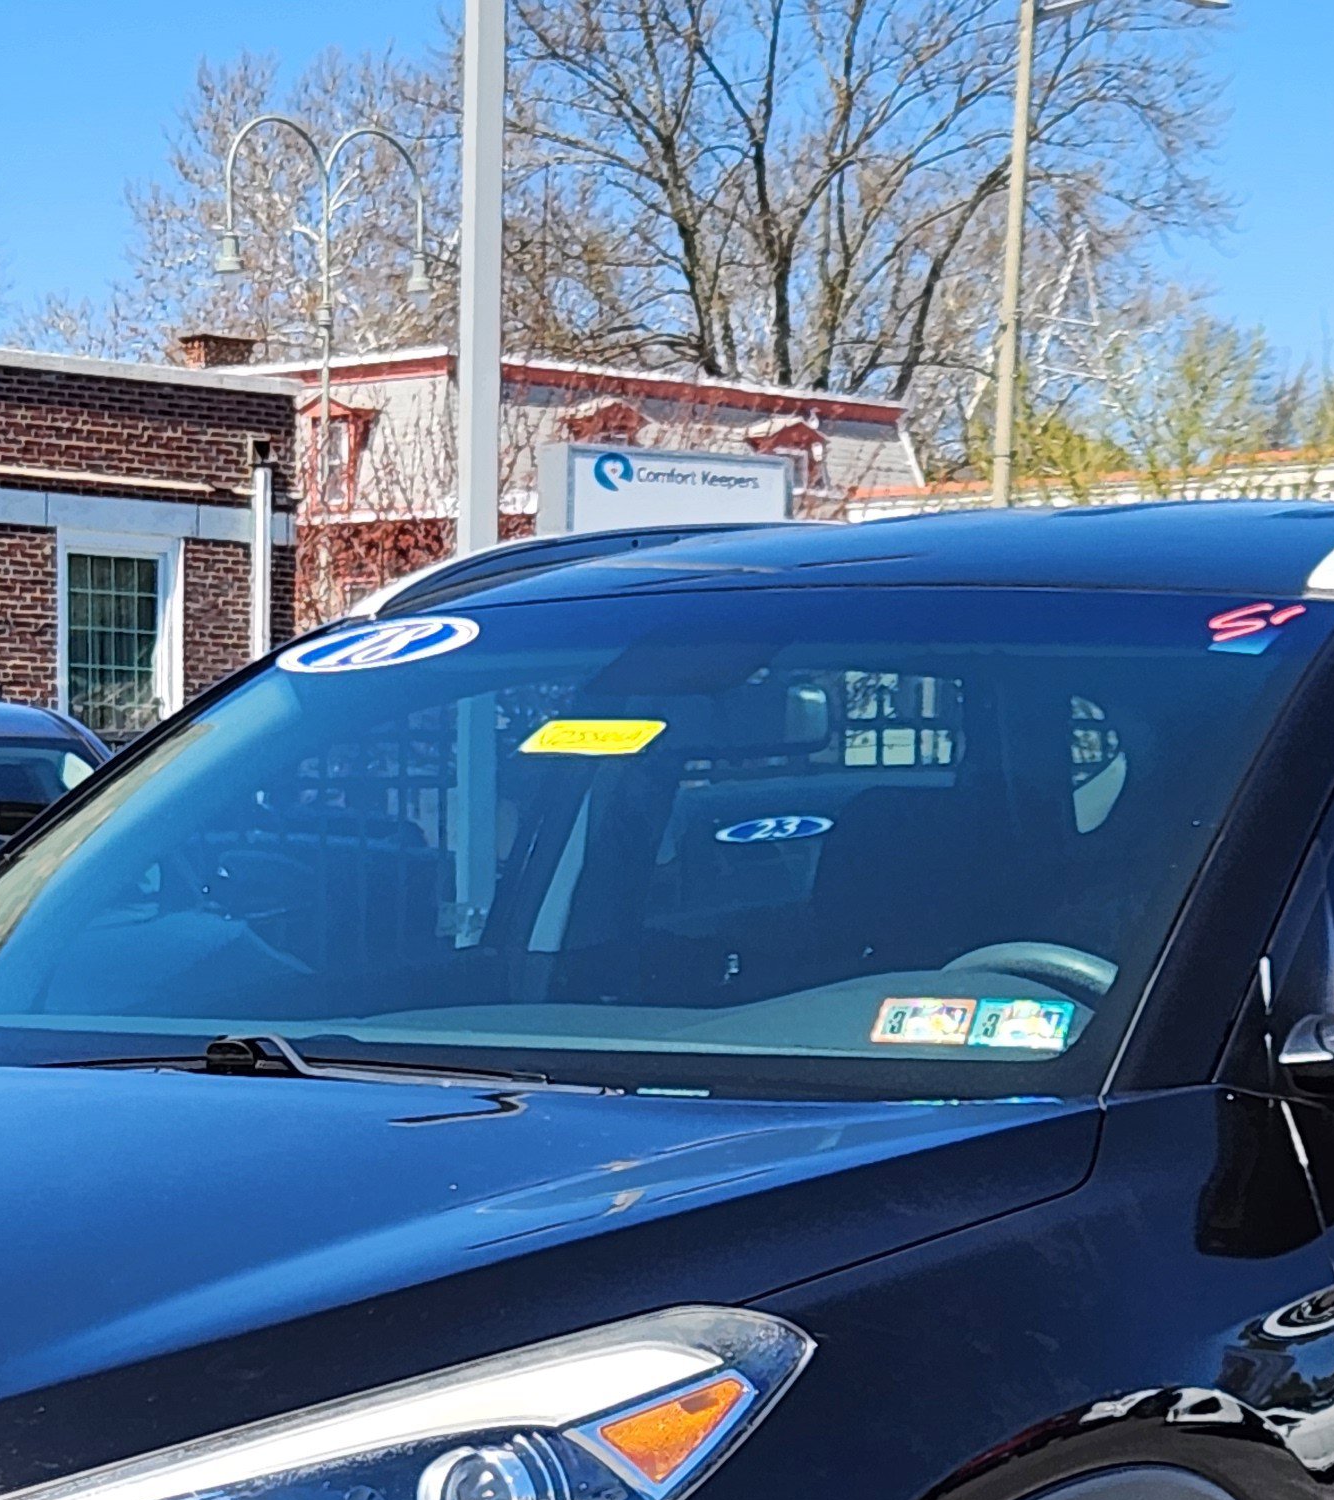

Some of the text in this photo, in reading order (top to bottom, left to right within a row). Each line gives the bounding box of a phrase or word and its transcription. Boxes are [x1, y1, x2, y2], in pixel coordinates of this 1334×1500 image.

[637, 466, 759, 490] Comfort Keepers
[749, 816, 802, 840] 23
